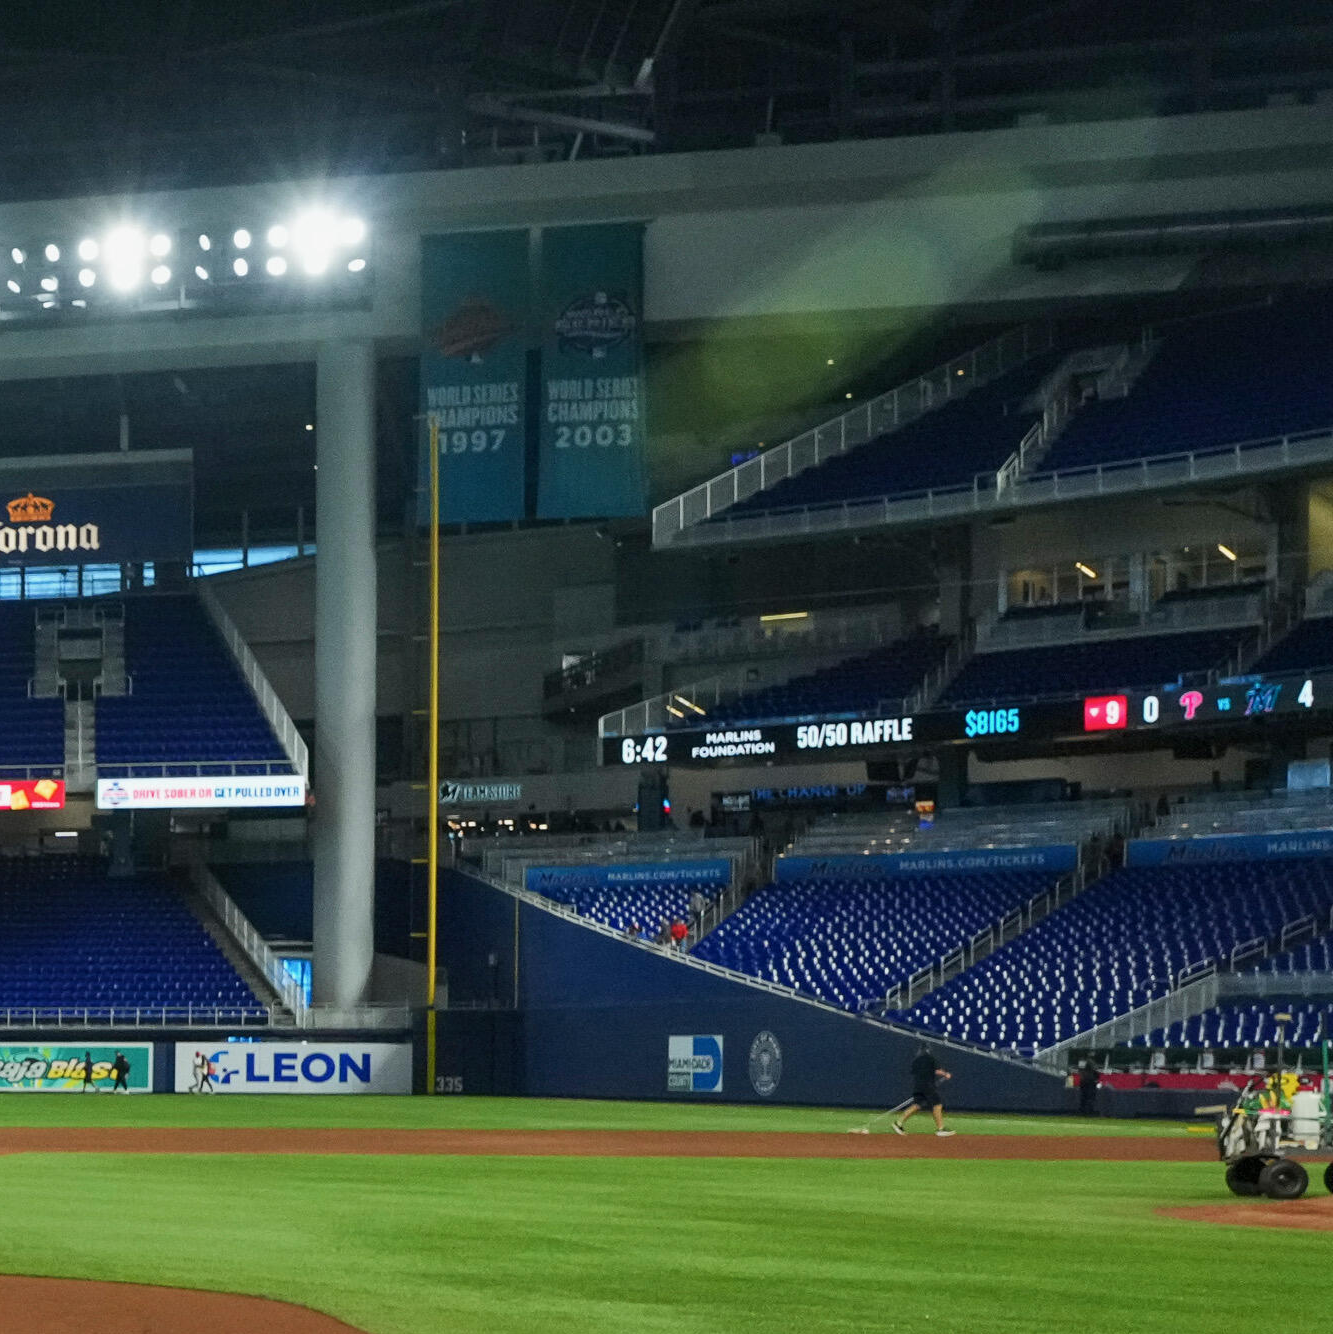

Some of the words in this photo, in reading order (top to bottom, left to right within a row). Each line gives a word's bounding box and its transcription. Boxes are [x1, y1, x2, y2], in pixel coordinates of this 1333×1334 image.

[547, 400, 639, 422] CHAMPIONS
[438, 429, 506, 453] 1997
[554, 424, 633, 448] 2003
[1105, 700, 1120, 725] 9
[1143, 696, 1159, 723] 0
[1298, 680, 1314, 708] 4
[705, 729, 762, 744] MARLINS
[797, 722, 848, 749] 50/50
[850, 717, 913, 745] RAFFLE
[621, 736, 668, 764] 6:42
[691, 741, 776, 759] FOUNDATION
[234, 787, 272, 798] PULLED
[245, 1053, 372, 1083] LEON
[436, 1076, 464, 1093] 335
